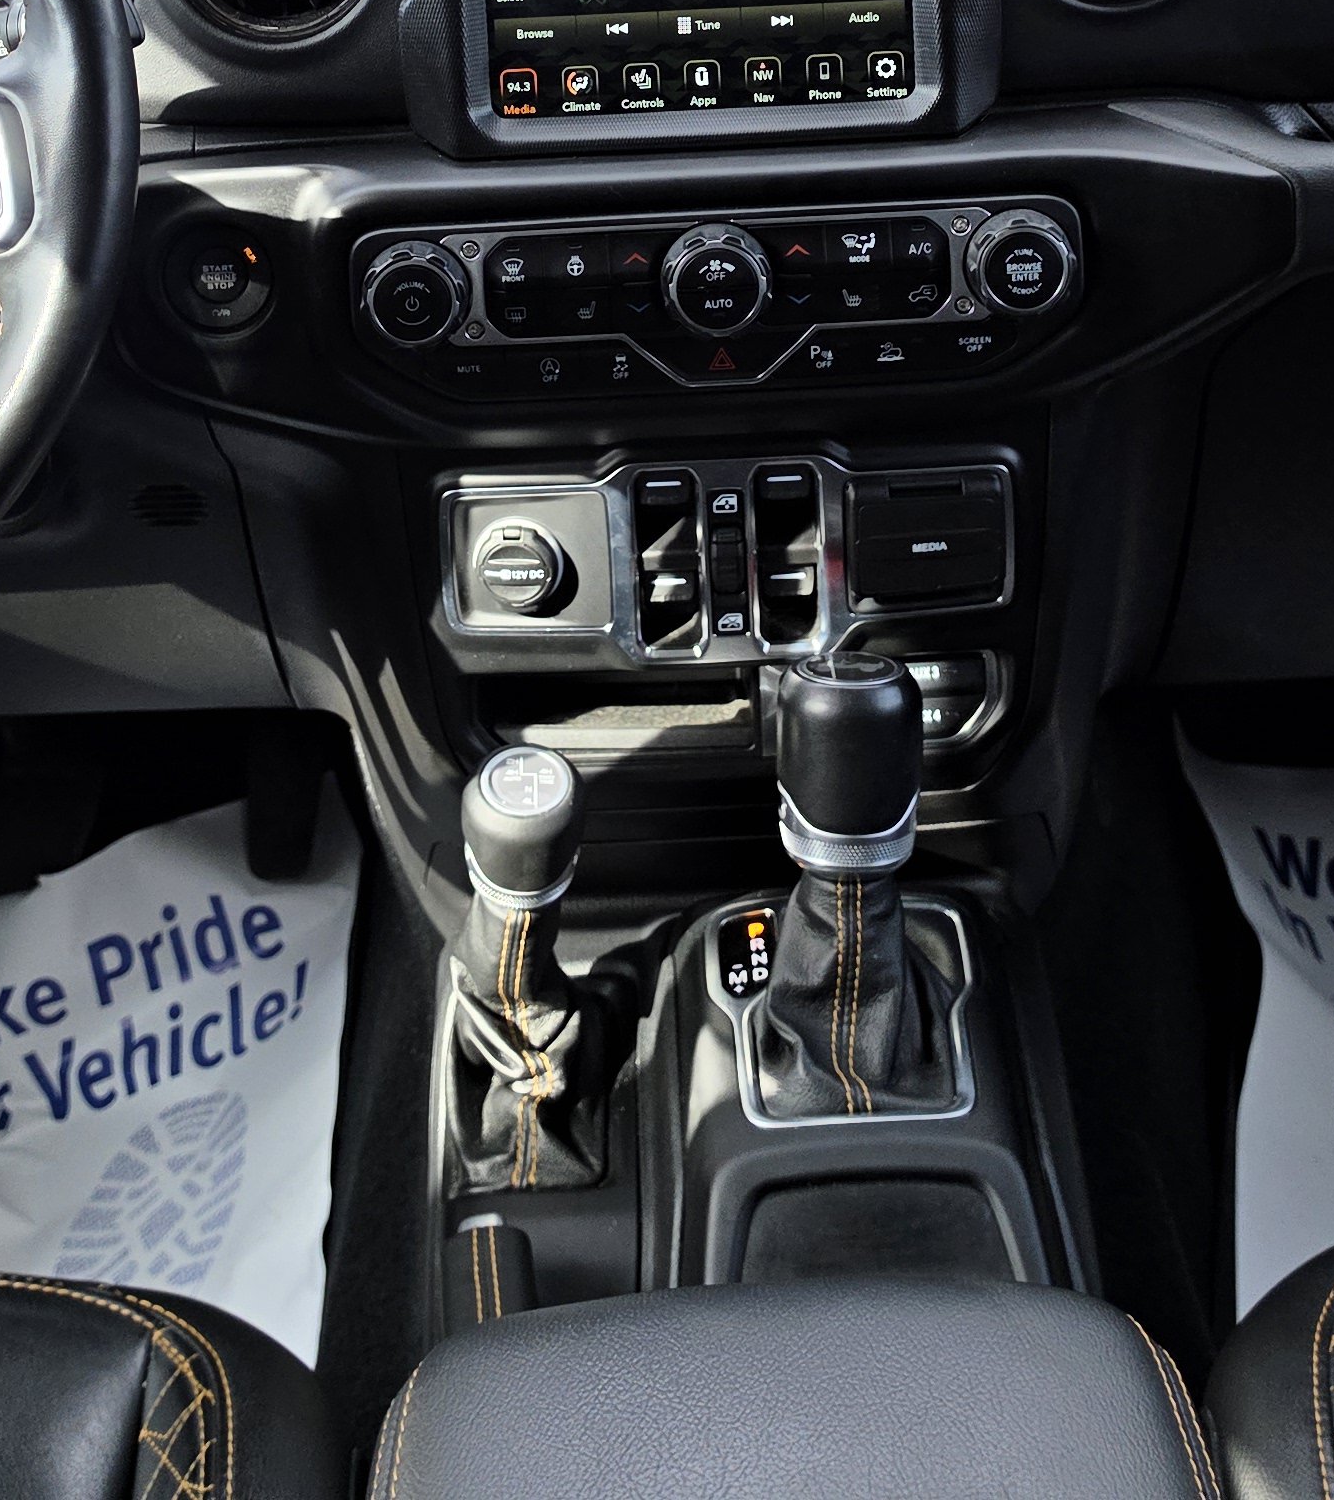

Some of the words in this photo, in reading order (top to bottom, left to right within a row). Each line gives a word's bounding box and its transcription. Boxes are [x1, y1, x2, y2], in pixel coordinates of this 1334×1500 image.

[849, 12, 880, 23] Audio
[695, 20, 720, 30] Tune
[517, 28, 554, 39] Browse
[753, 70, 773, 81] NW
[507, 82, 531, 93] 94.3
[867, 87, 907, 99] Settings
[754, 92, 774, 103] Nav
[809, 90, 842, 100] Phone
[562, 101, 601, 113] Climate
[621, 97, 664, 109] Controls
[690, 96, 717, 107] Apps
[504, 105, 536, 116] Media
[909, 242, 932, 255] A/C
[1013, 249, 1034, 257] TUNE
[849, 255, 870, 263] MODE
[202, 264, 234, 273] START
[1007, 262, 1042, 272] BROWSE
[501, 275, 525, 283] FRONT
[706, 272, 726, 281] OFF
[1012, 273, 1039, 282] ENTER
[207, 281, 234, 290] STOP
[398, 282, 425, 292] VOLUME
[1012, 285, 1039, 295] SCROLL
[704, 299, 733, 309] AUTO
[959, 336, 992, 345] SCREEN
[967, 344, 982, 352] OFF
[457, 365, 482, 373] MUTE
[816, 360, 832, 368] OFF
[542, 373, 560, 382] OFF
[613, 371, 629, 379] OFF
[912, 541, 947, 553] MEDIA
[511, 569, 528, 580] 12V
[528, 569, 545, 580] DC
[748, 922, 764, 938] P
[87, 894, 284, 1007] Pride
[749, 938, 765, 952] R
[751, 951, 768, 967] N
[728, 969, 748, 986] M
[752, 967, 769, 981] D
[24, 959, 310, 1123] Vehicle!
